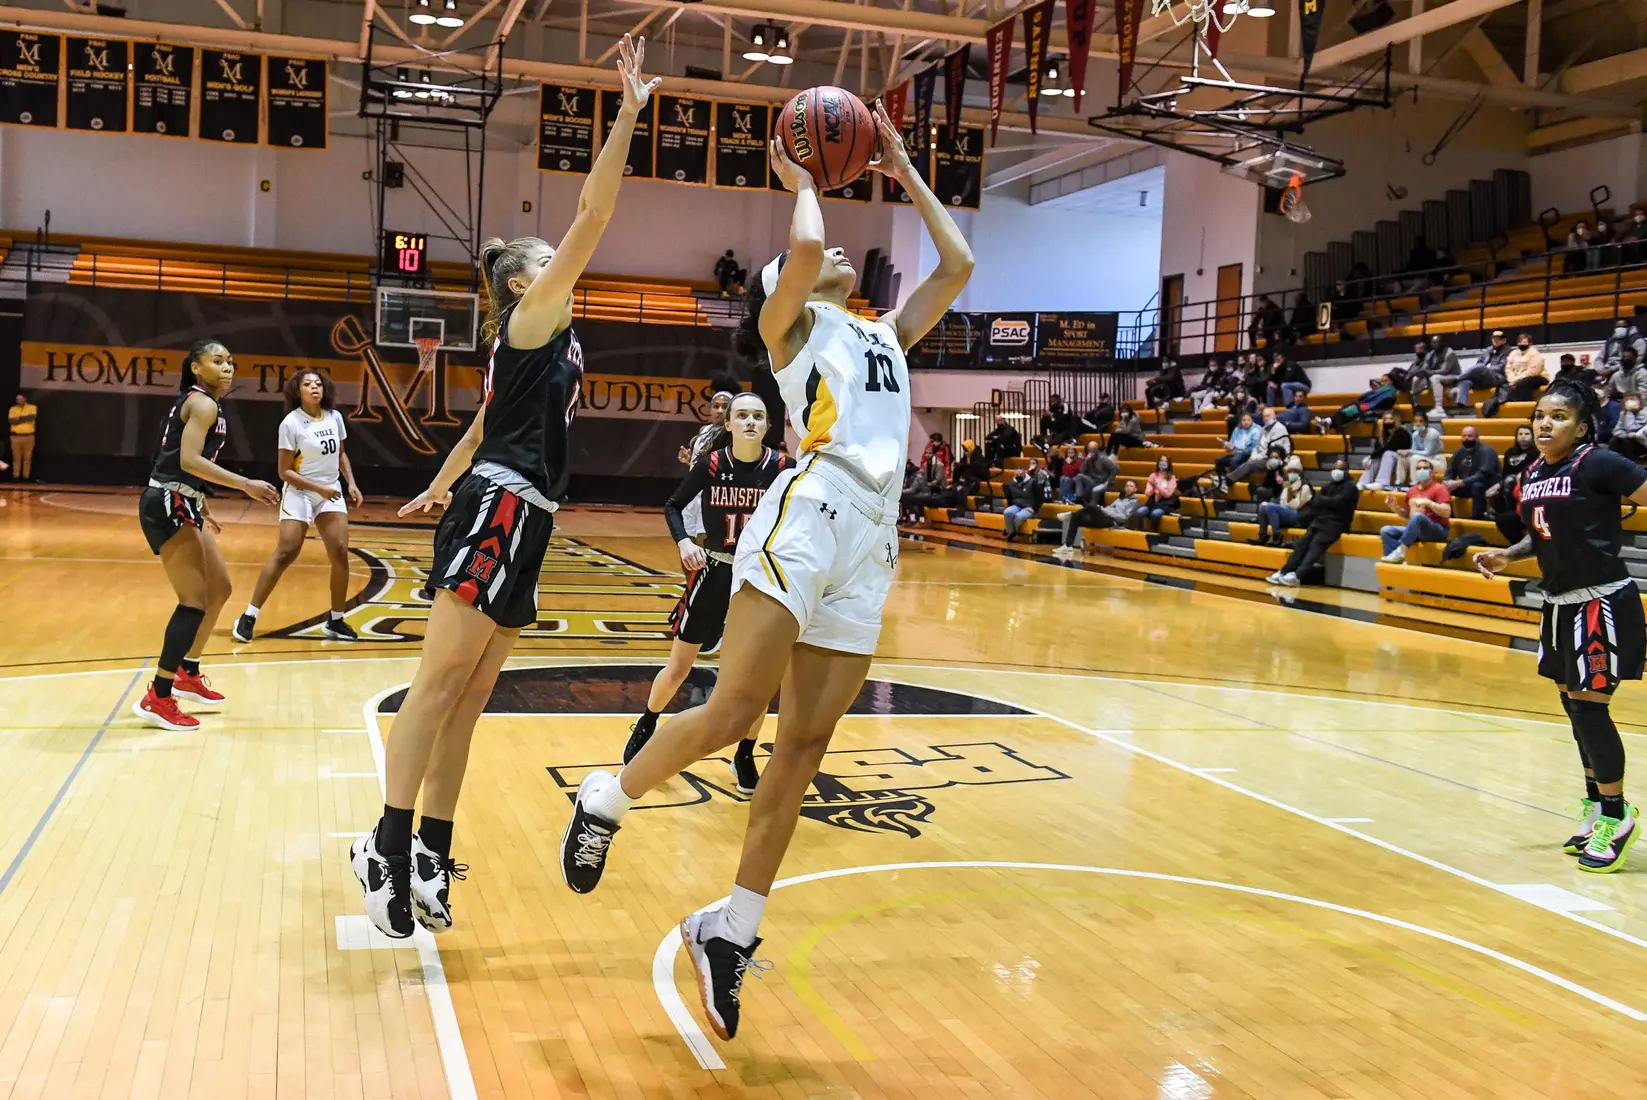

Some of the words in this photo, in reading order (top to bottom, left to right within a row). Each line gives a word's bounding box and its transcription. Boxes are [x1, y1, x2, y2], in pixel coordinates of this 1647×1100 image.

[1028, 11, 1043, 98] GANNON
[991, 30, 1004, 120] EDINBORO
[395, 235, 424, 250] 6:11
[399, 249, 419, 271] 10
[992, 326, 1029, 339] PSAC
[1048, 337, 1106, 349] MANAGEMENT
[43, 349, 174, 390] HOME
[864, 348, 901, 393] 10
[313, 428, 335, 438] VILLE
[320, 438, 337, 455] 30
[1532, 505, 1552, 540] 4
[466, 550, 498, 583] M
